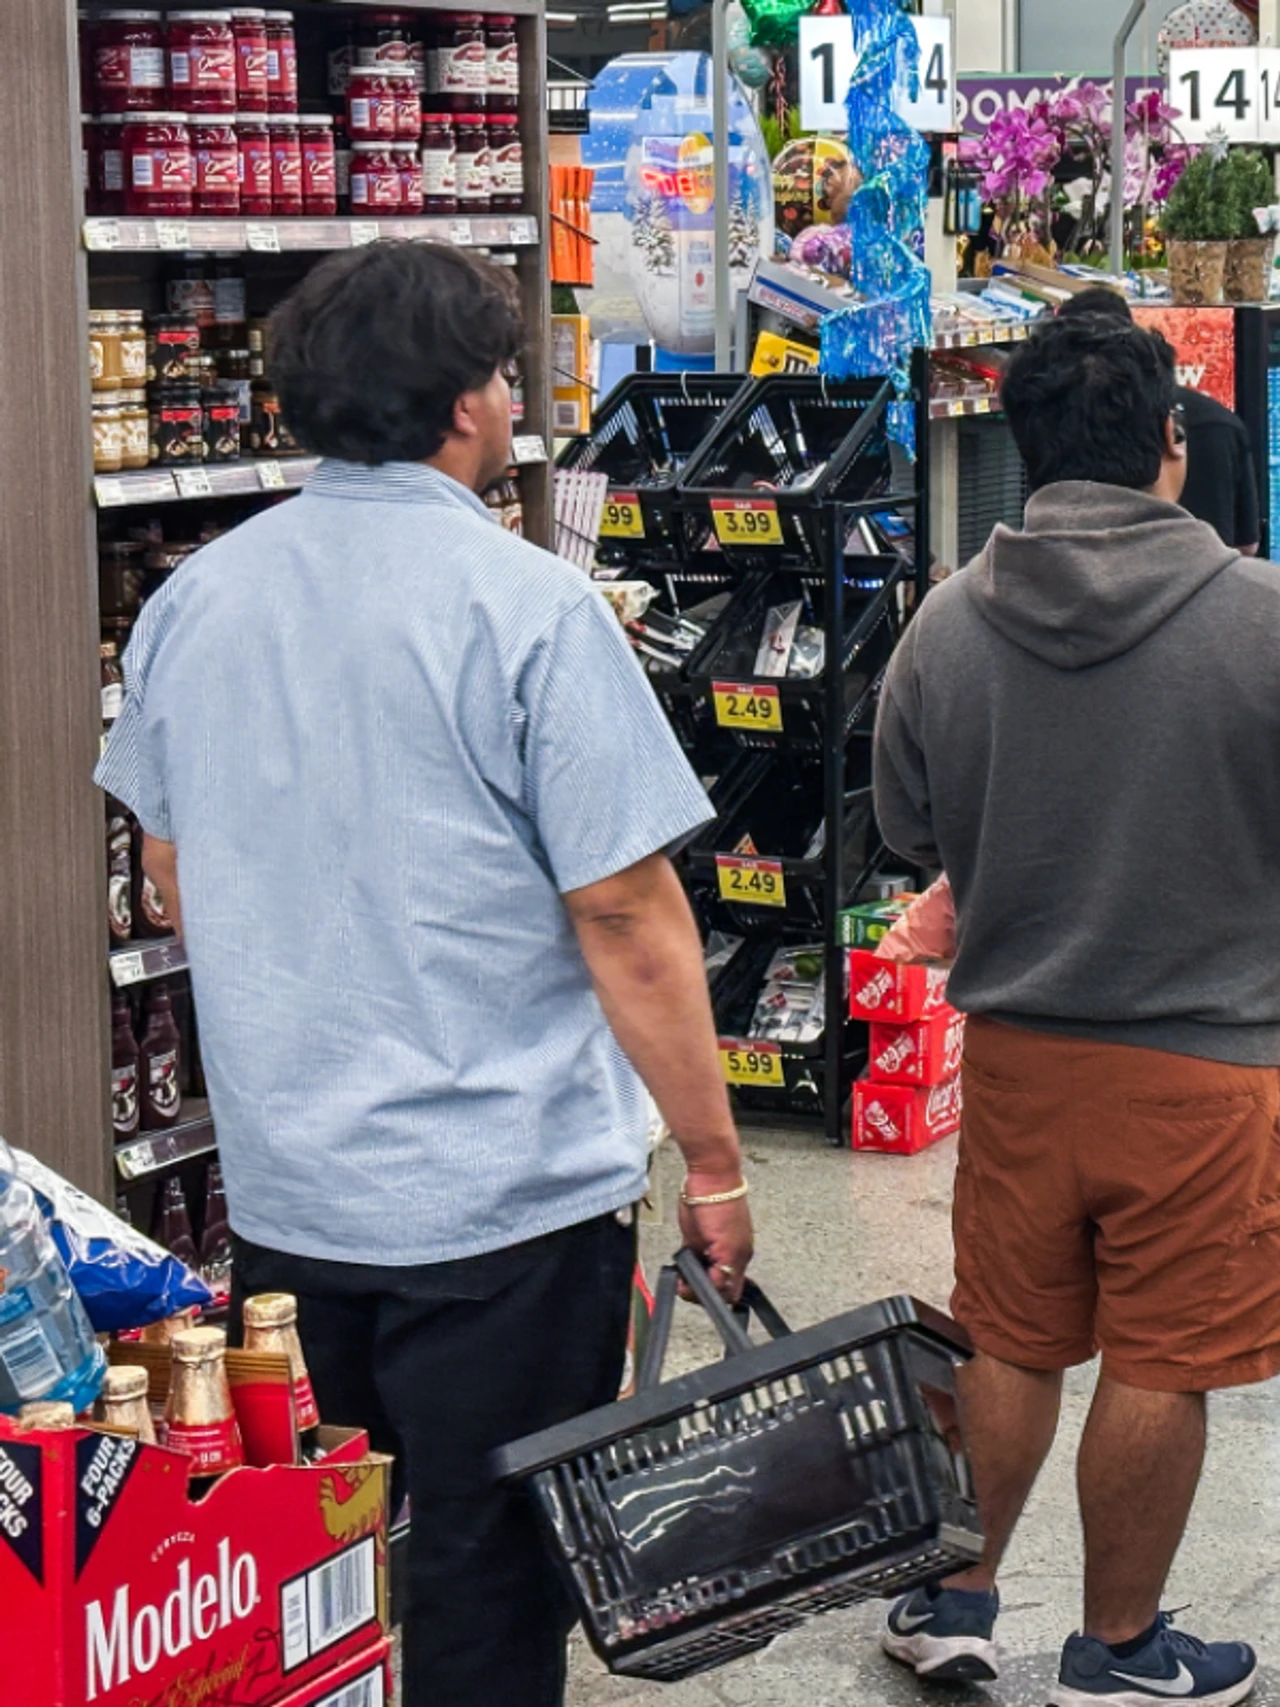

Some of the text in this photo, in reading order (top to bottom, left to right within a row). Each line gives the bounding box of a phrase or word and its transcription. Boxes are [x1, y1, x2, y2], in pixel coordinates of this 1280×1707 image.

[1179, 68, 1251, 121] 14
[603, 505, 633, 526] .99
[723, 512, 771, 533] 3.99
[725, 694, 773, 719] 2.49
[730, 869, 776, 893] 2.49
[727, 1051, 774, 1075] 5.99
[80, 1435, 116, 1497] FOUR
[85, 1438, 137, 1528] 6-PACKS
[85, 1536, 259, 1702] Modelo
